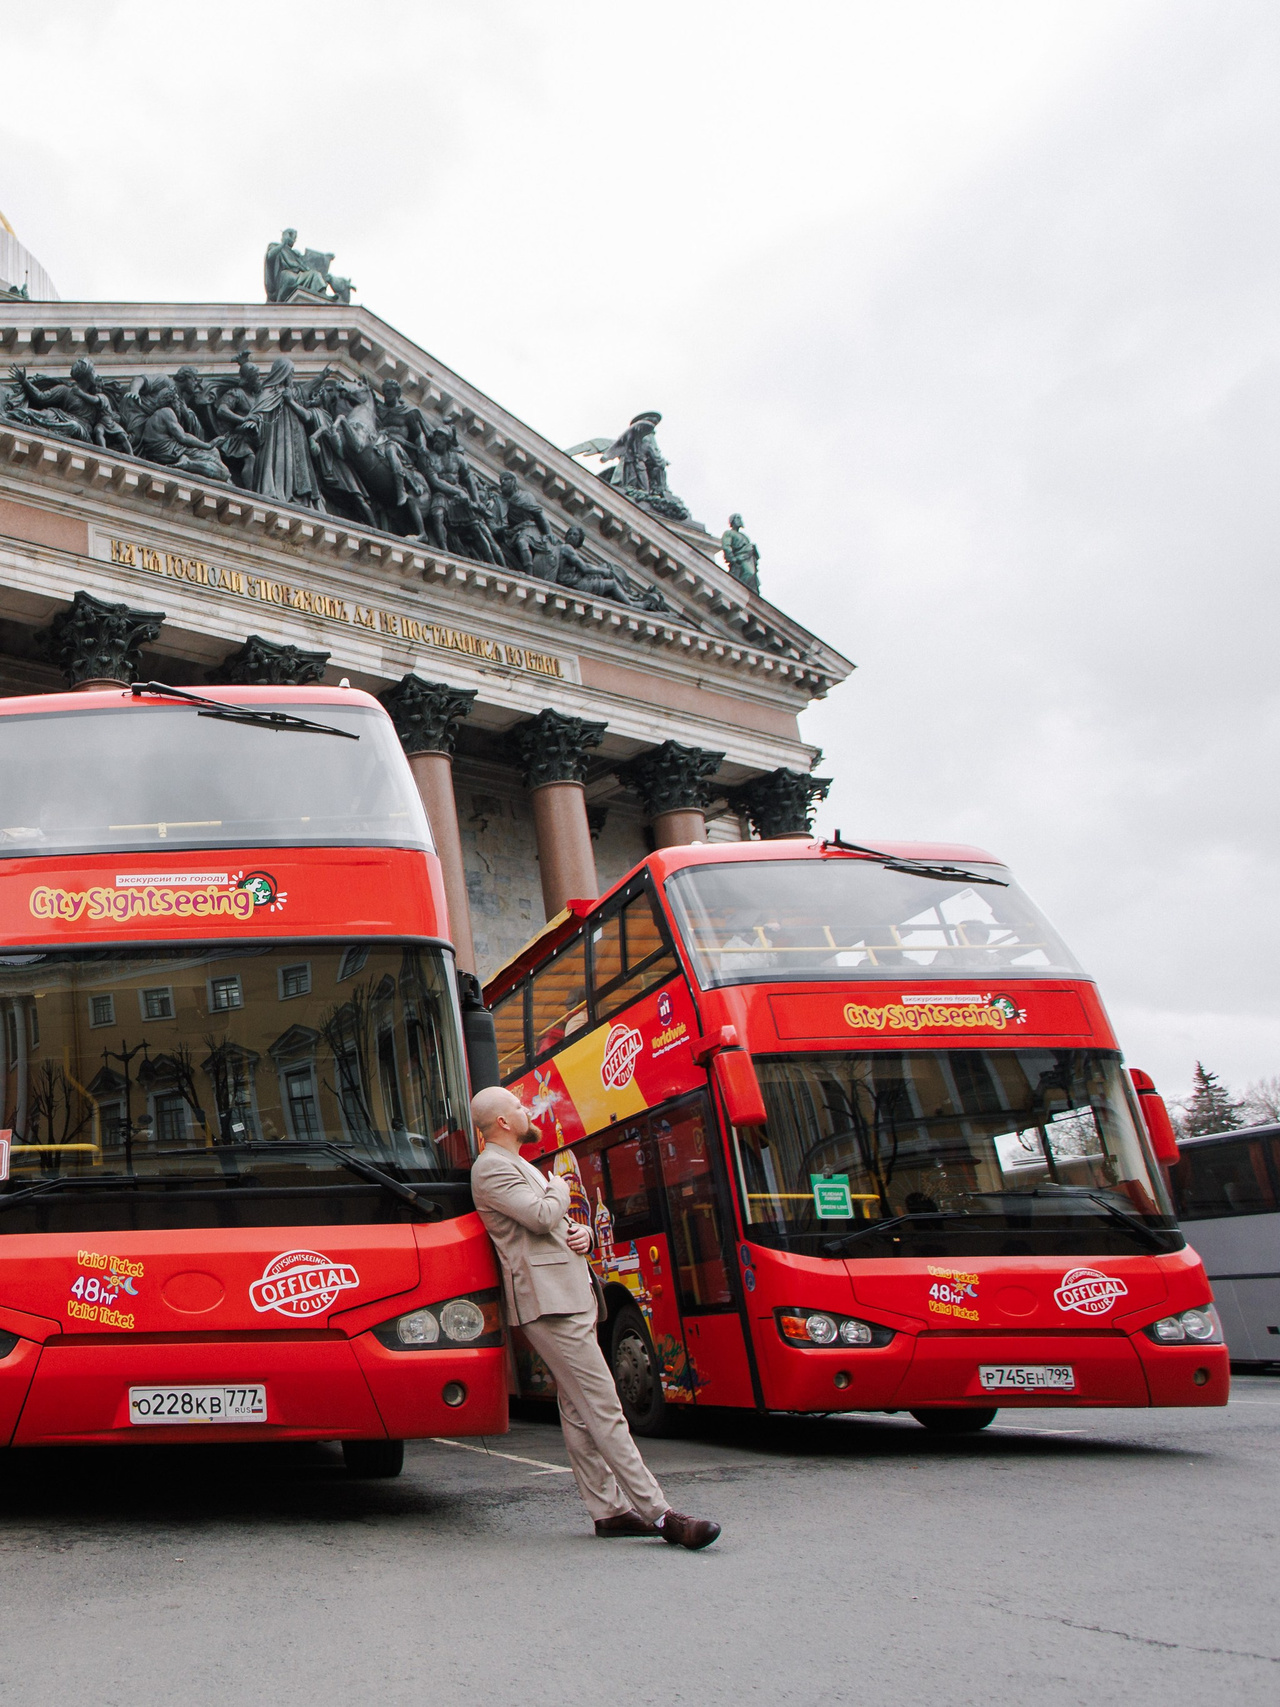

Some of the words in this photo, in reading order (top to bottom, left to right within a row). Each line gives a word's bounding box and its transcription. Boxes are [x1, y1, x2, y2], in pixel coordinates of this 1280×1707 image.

[118, 875, 172, 885] экскурсии
[174, 875, 187, 883] по
[190, 874, 226, 885] городу
[604, 1034, 640, 1081] OFFICIAL
[618, 1061, 634, 1084] TOUR
[78, 1250, 108, 1270] Valid
[109, 1256, 144, 1277] Ticket
[271, 1254, 326, 1276] CITYSIGHTSEEING
[927, 1265, 951, 1279] Valid
[951, 1270, 979, 1285] Ticket
[71, 1276, 118, 1306] 48hr
[261, 1269, 352, 1303] OFFICIAL
[929, 1283, 964, 1304] 48hr
[1062, 1281, 1123, 1304] OFFICIAL
[292, 1292, 332, 1312] TOUR
[928, 1300, 951, 1315] Valid
[952, 1305, 979, 1321] Ticket
[1085, 1297, 1112, 1311] TOUR
[67, 1300, 98, 1321] Valid
[100, 1307, 134, 1329] Ticket
[1047, 1368, 1069, 1380] 799
[226, 1390, 258, 1407] 777
